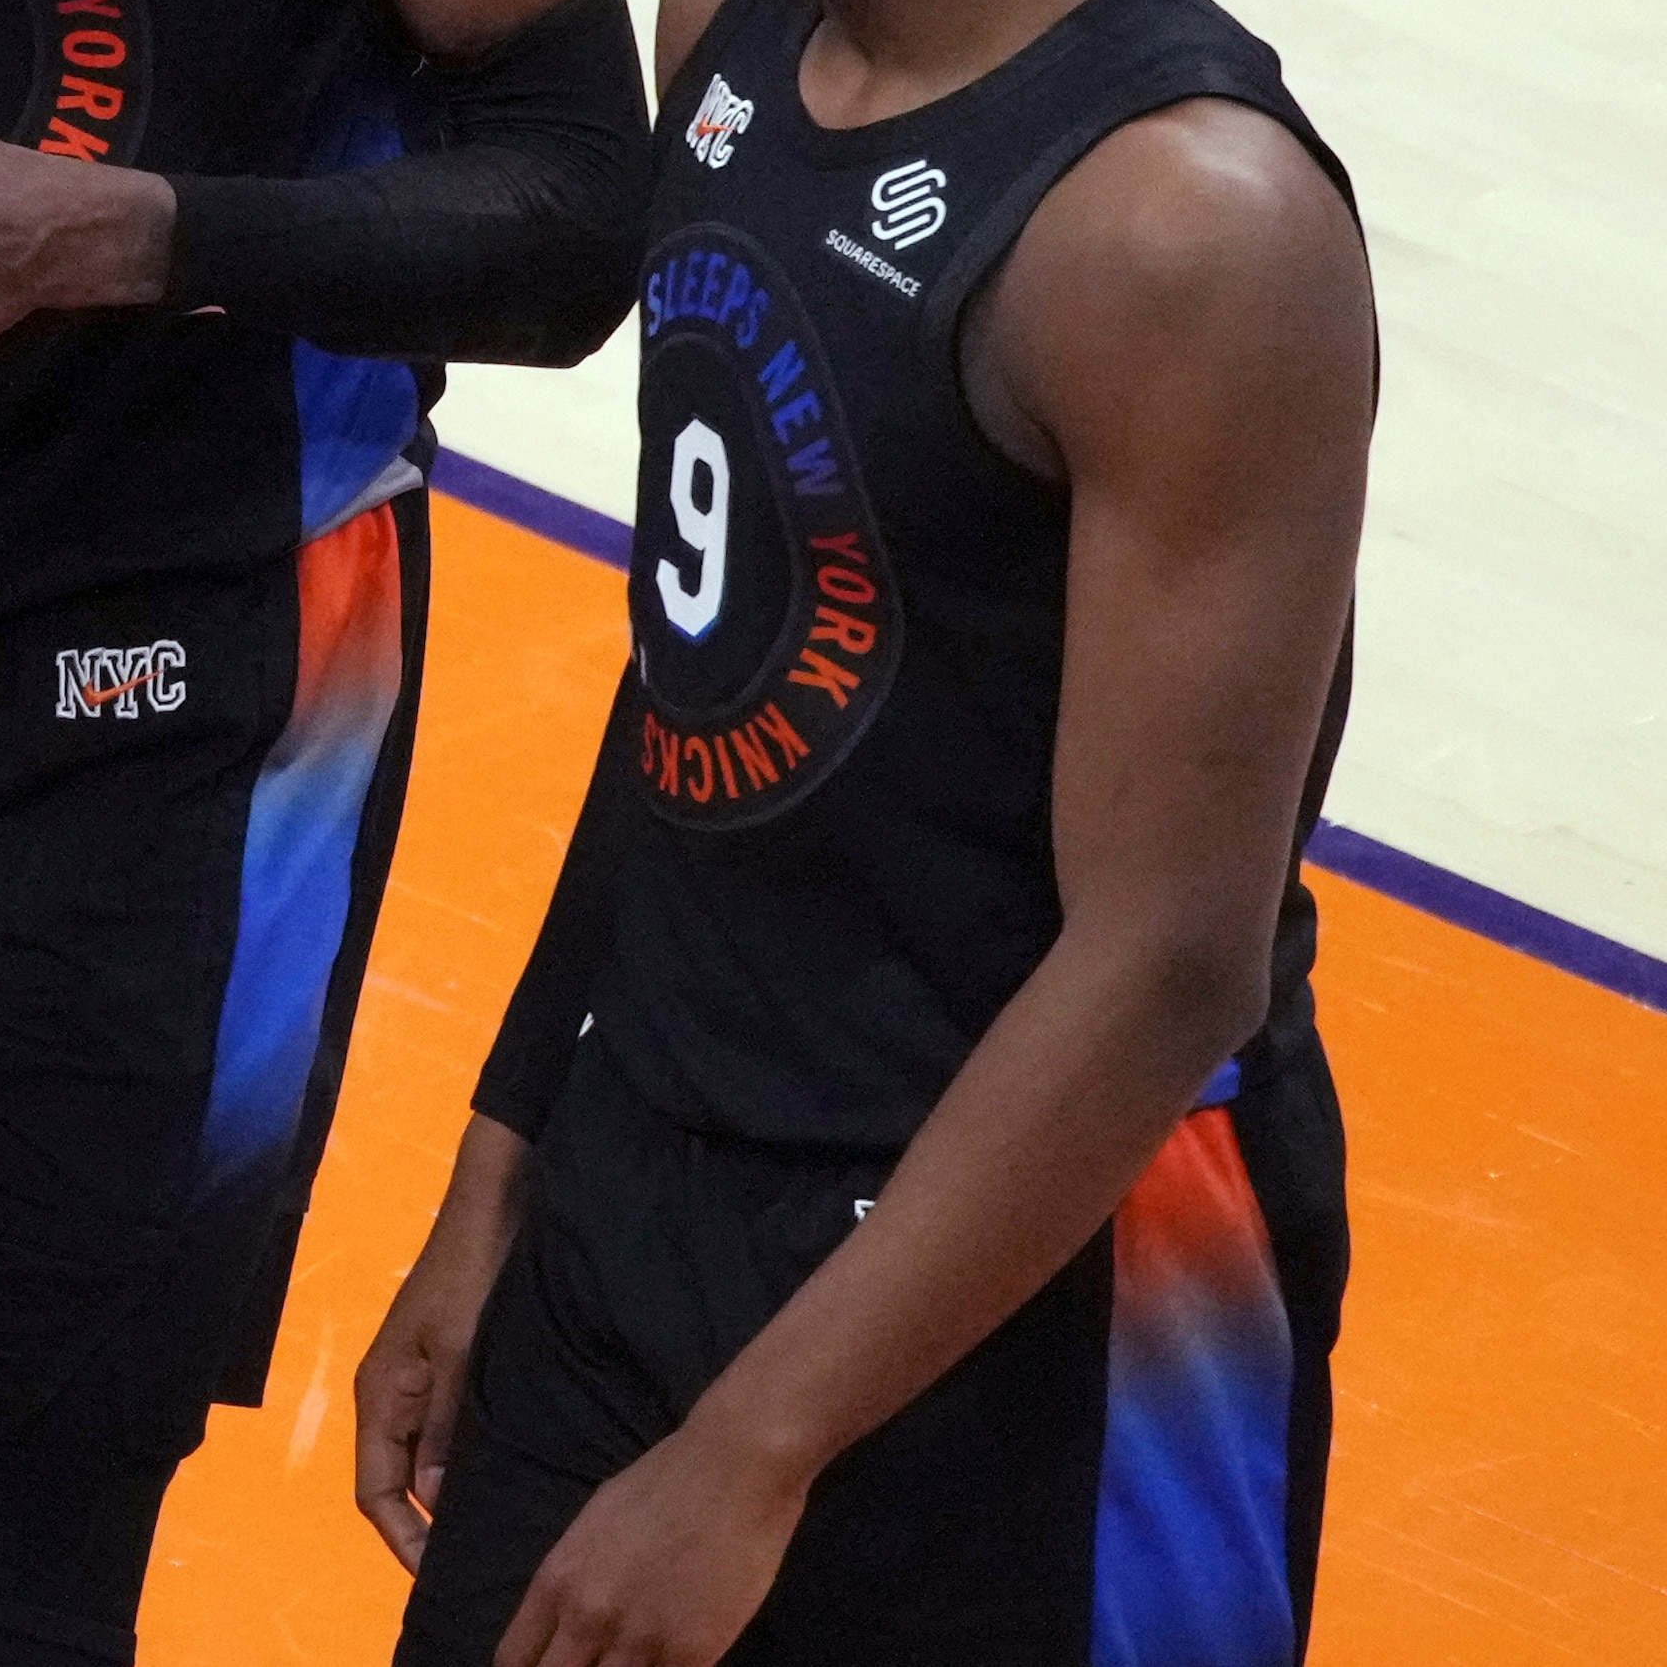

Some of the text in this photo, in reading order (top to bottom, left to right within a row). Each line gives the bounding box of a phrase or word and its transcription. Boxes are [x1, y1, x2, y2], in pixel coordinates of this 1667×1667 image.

[825, 229, 922, 297] SQUARESPACE
[643, 250, 876, 803] SLEEPS NEW YORK KNICKS
[655, 418, 730, 639] 9
[57, 640, 186, 719] NYC
